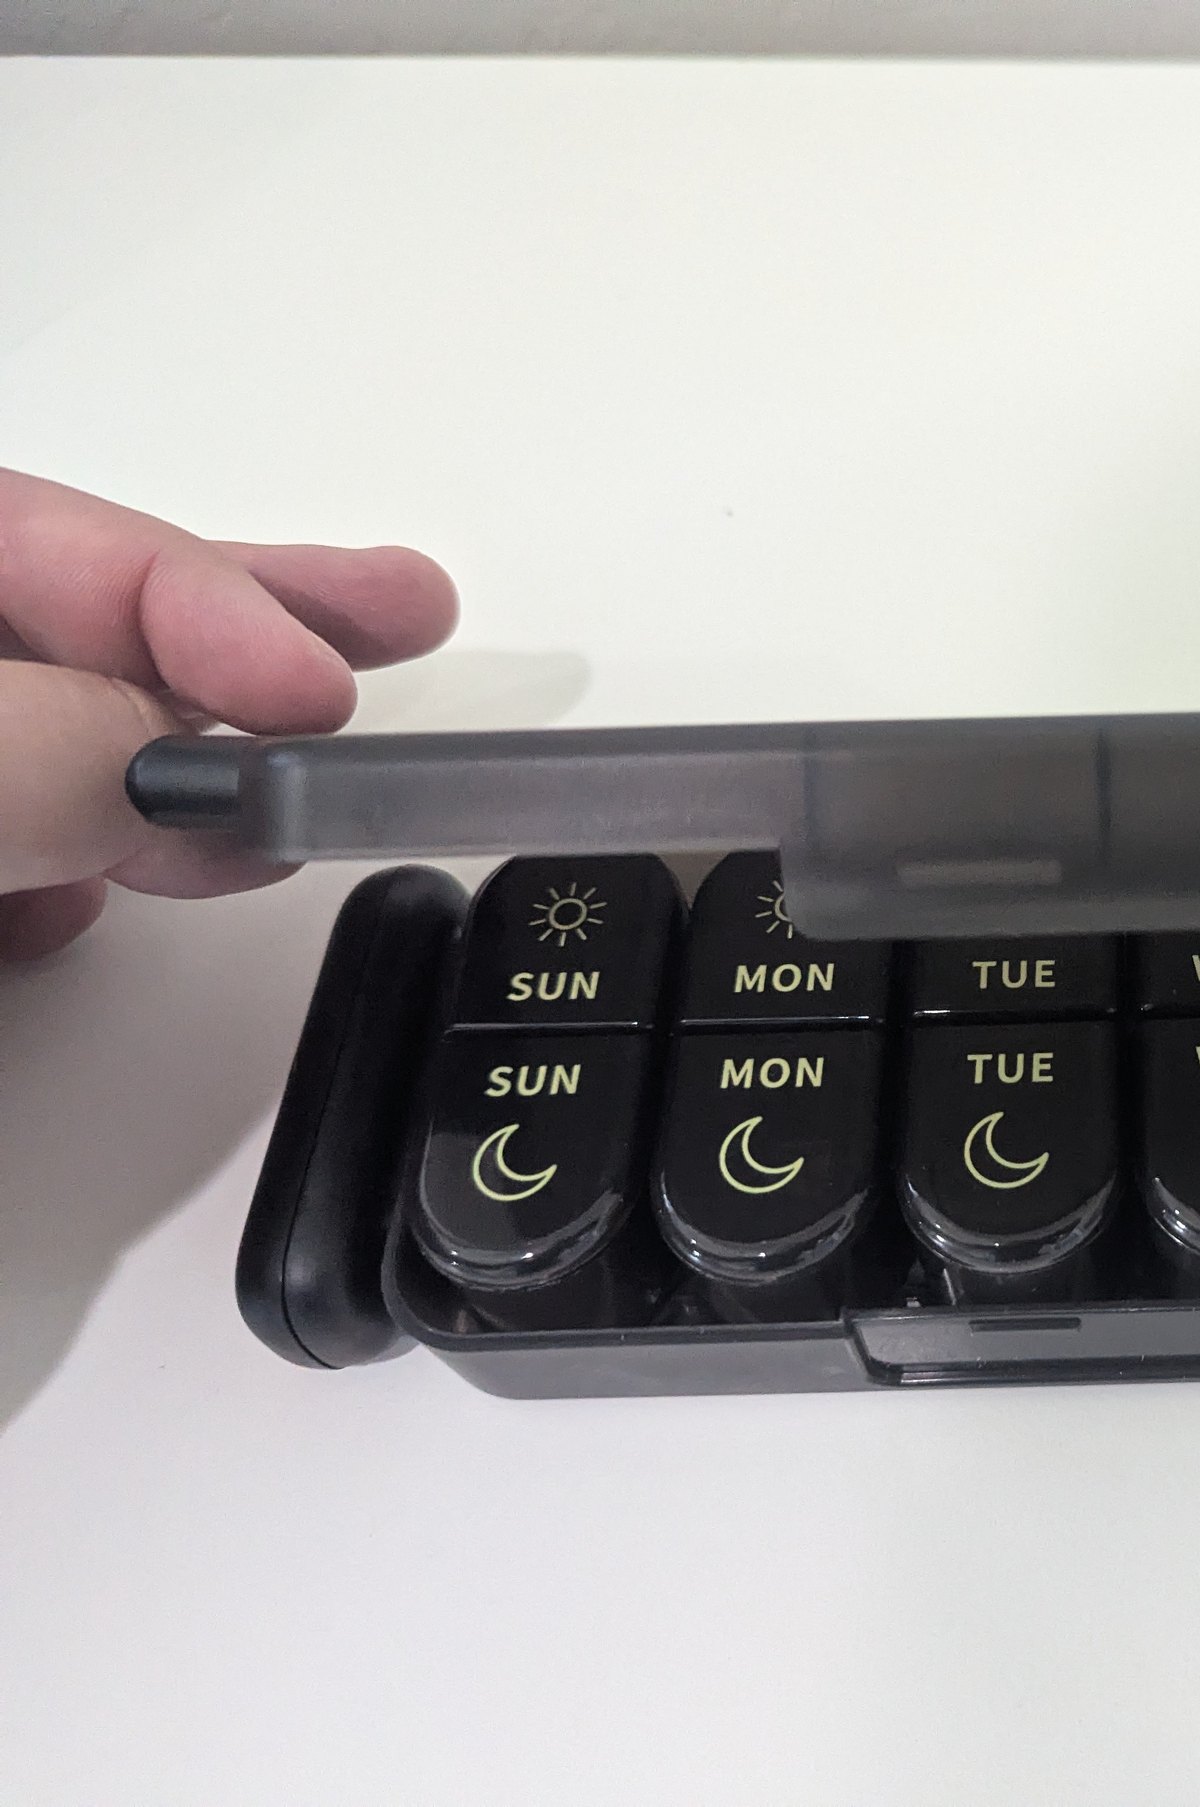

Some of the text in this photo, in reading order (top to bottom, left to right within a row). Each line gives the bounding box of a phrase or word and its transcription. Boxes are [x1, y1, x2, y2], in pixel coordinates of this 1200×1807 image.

[506, 971, 601, 1003] SUN
[733, 962, 835, 994] MON
[972, 957, 1056, 990] TUE
[484, 1063, 583, 1099] SUN
[718, 1055, 826, 1091] MON
[966, 1051, 1055, 1085] TUE
